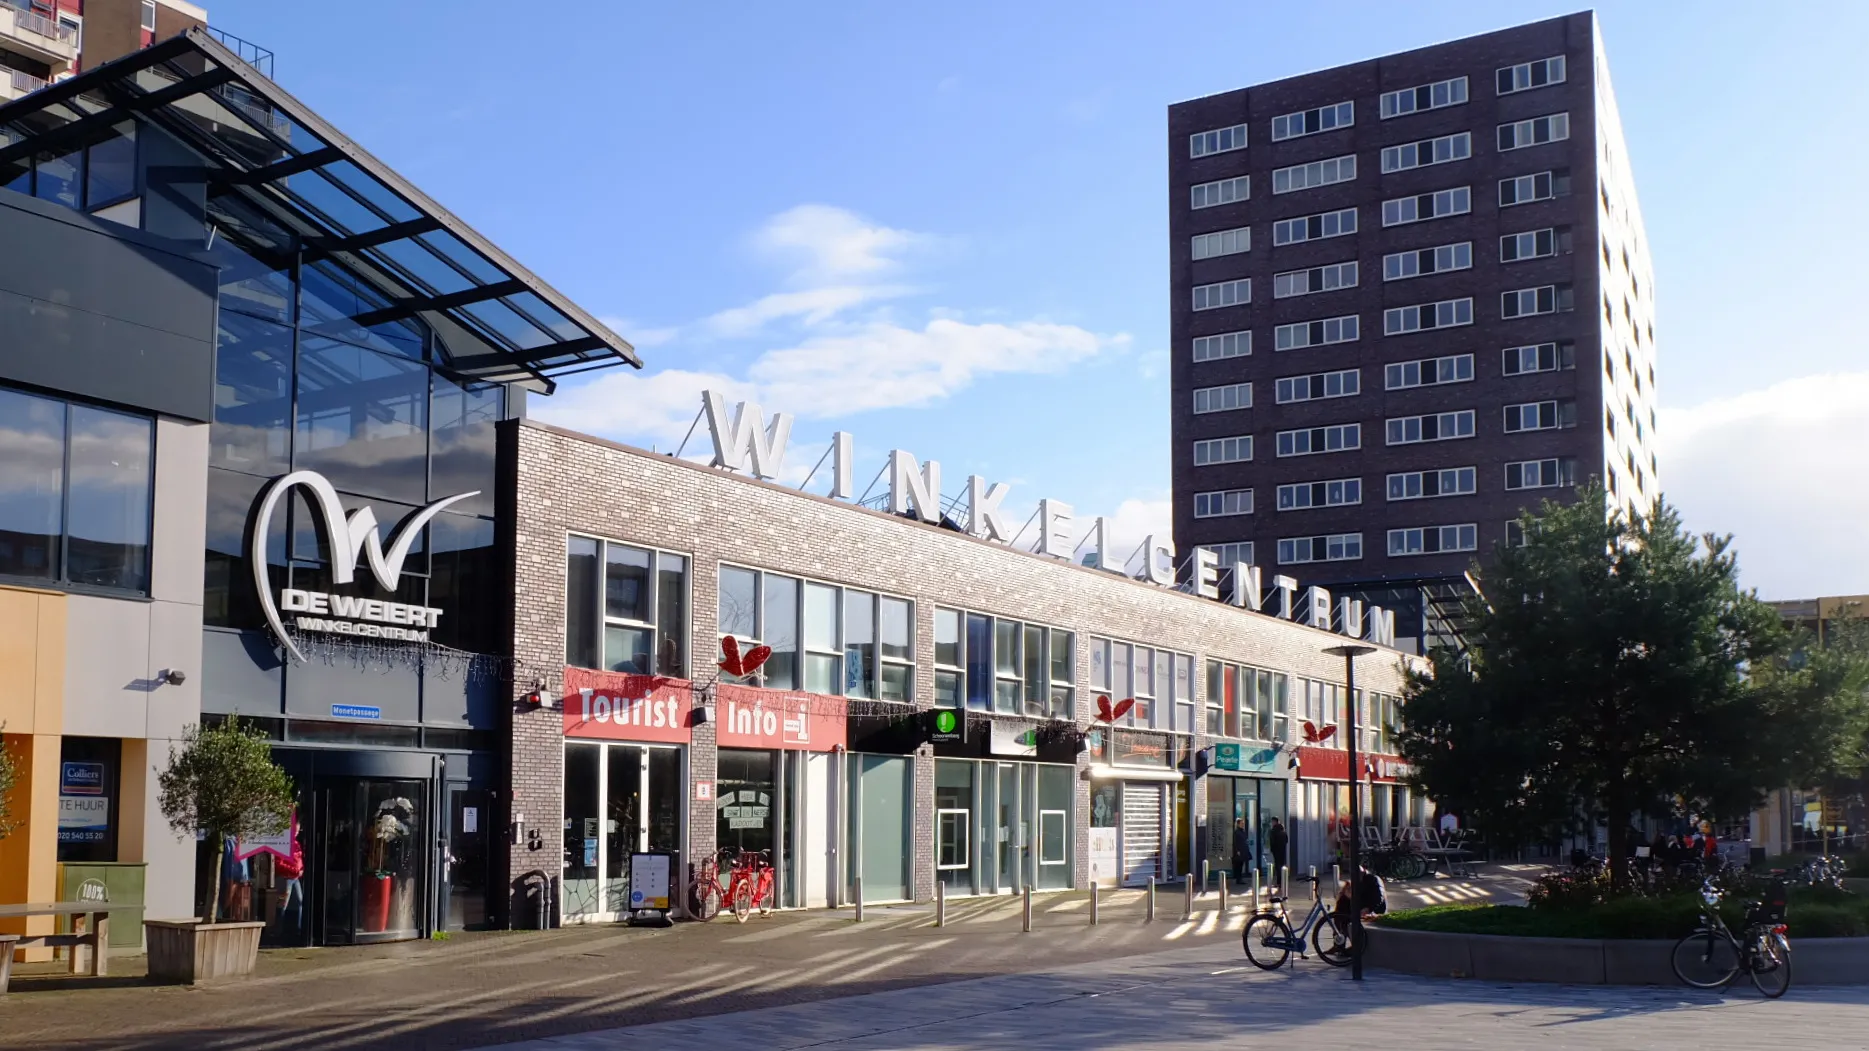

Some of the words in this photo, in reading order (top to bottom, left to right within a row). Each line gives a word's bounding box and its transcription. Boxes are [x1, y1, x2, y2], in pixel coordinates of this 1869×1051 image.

[702, 389, 1396, 648] WINKELCENTRUM
[281, 588, 328, 614] DE
[330, 594, 443, 628] WEIERT
[297, 616, 428, 642] WINKELCENTRUM
[333, 706, 379, 718] Monetpassage
[579, 687, 678, 728] Tourist
[728, 699, 777, 736] Info
[67, 768, 99, 778] Colliers
[59, 800, 72, 811] TE
[74, 801, 105, 811] HUUR
[71, 832, 84, 840] 540
[82, 883, 105, 901] 100%
